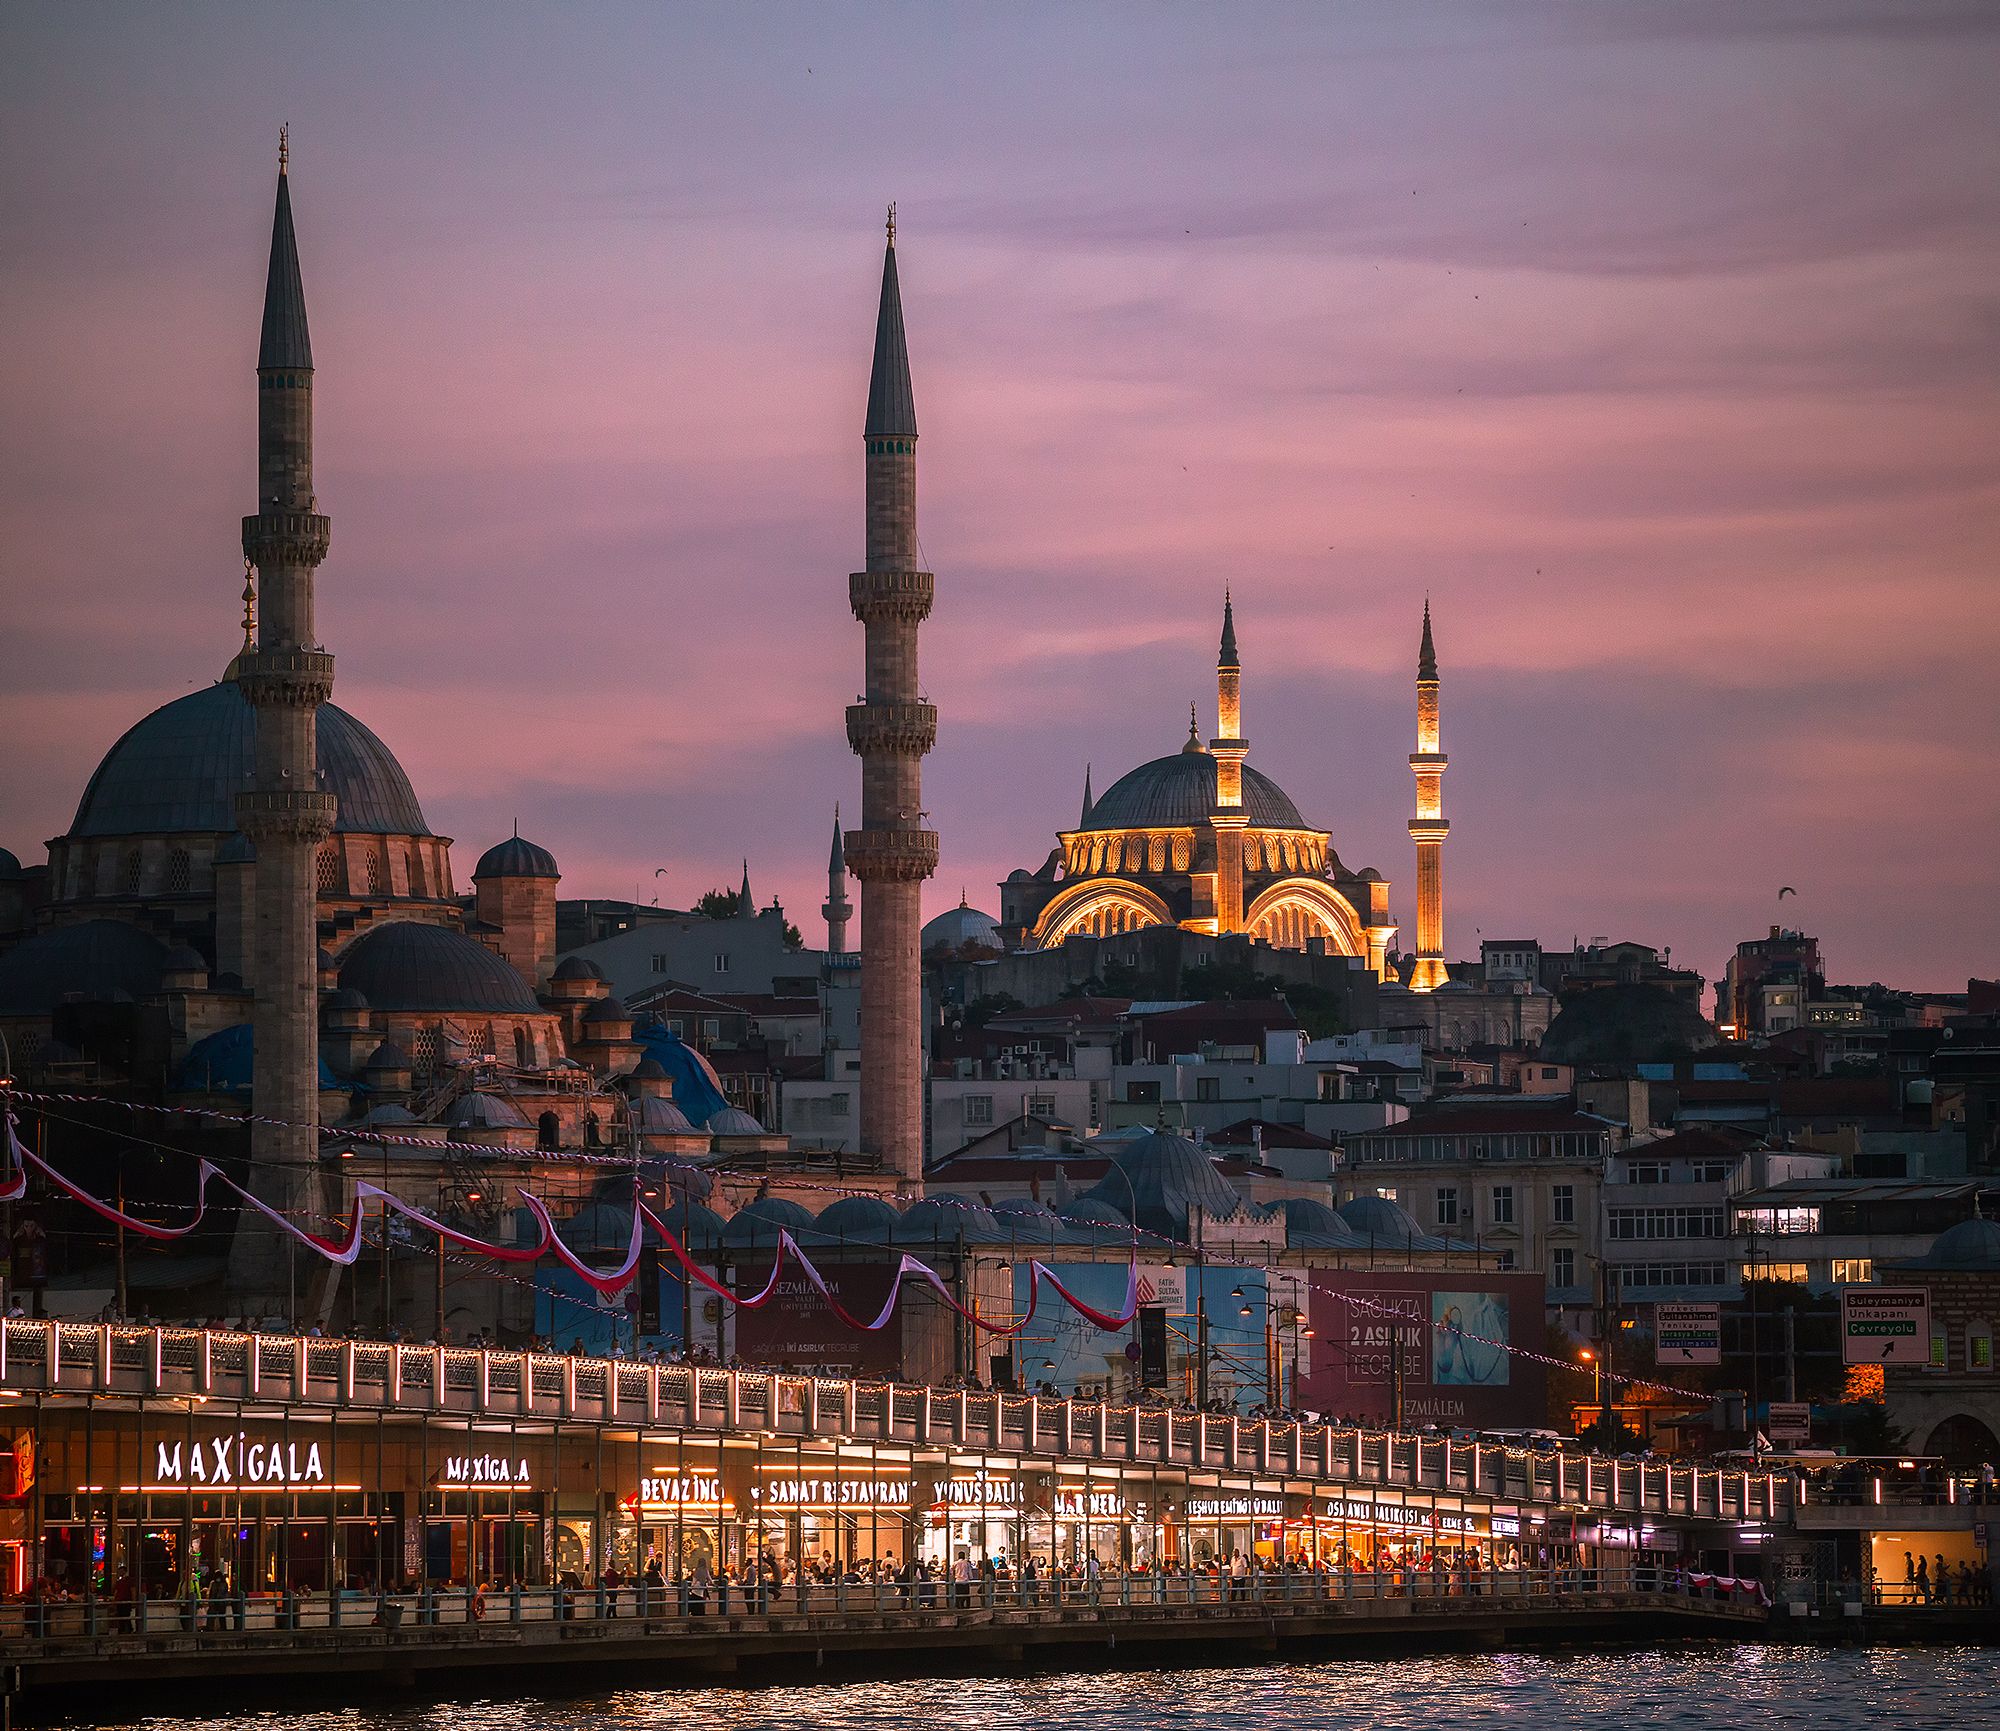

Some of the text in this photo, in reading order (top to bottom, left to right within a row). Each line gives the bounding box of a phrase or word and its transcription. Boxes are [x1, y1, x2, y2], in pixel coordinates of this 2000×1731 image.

[1158, 1287, 1180, 1295] SULTAN
[1660, 1312, 1716, 1320] Sultanahmet
[1849, 1310, 1908, 1321] Unkapanı
[1350, 1326, 1360, 1346] 2
[1850, 1323, 1914, 1335] Çevreyolu
[787, 1342, 797, 1353] İKİ
[1351, 1354, 1421, 1376] TECRBE
[1404, 1397, 1464, 1416] EZMİÂLEM
[157, 1431, 324, 1485] MAXİGALA
[446, 1453, 530, 1482] MAXİGAA
[640, 1478, 690, 1502] BEYAZ
[769, 1480, 819, 1503] SANAT
[1055, 1493, 1126, 1515] MARNERO
